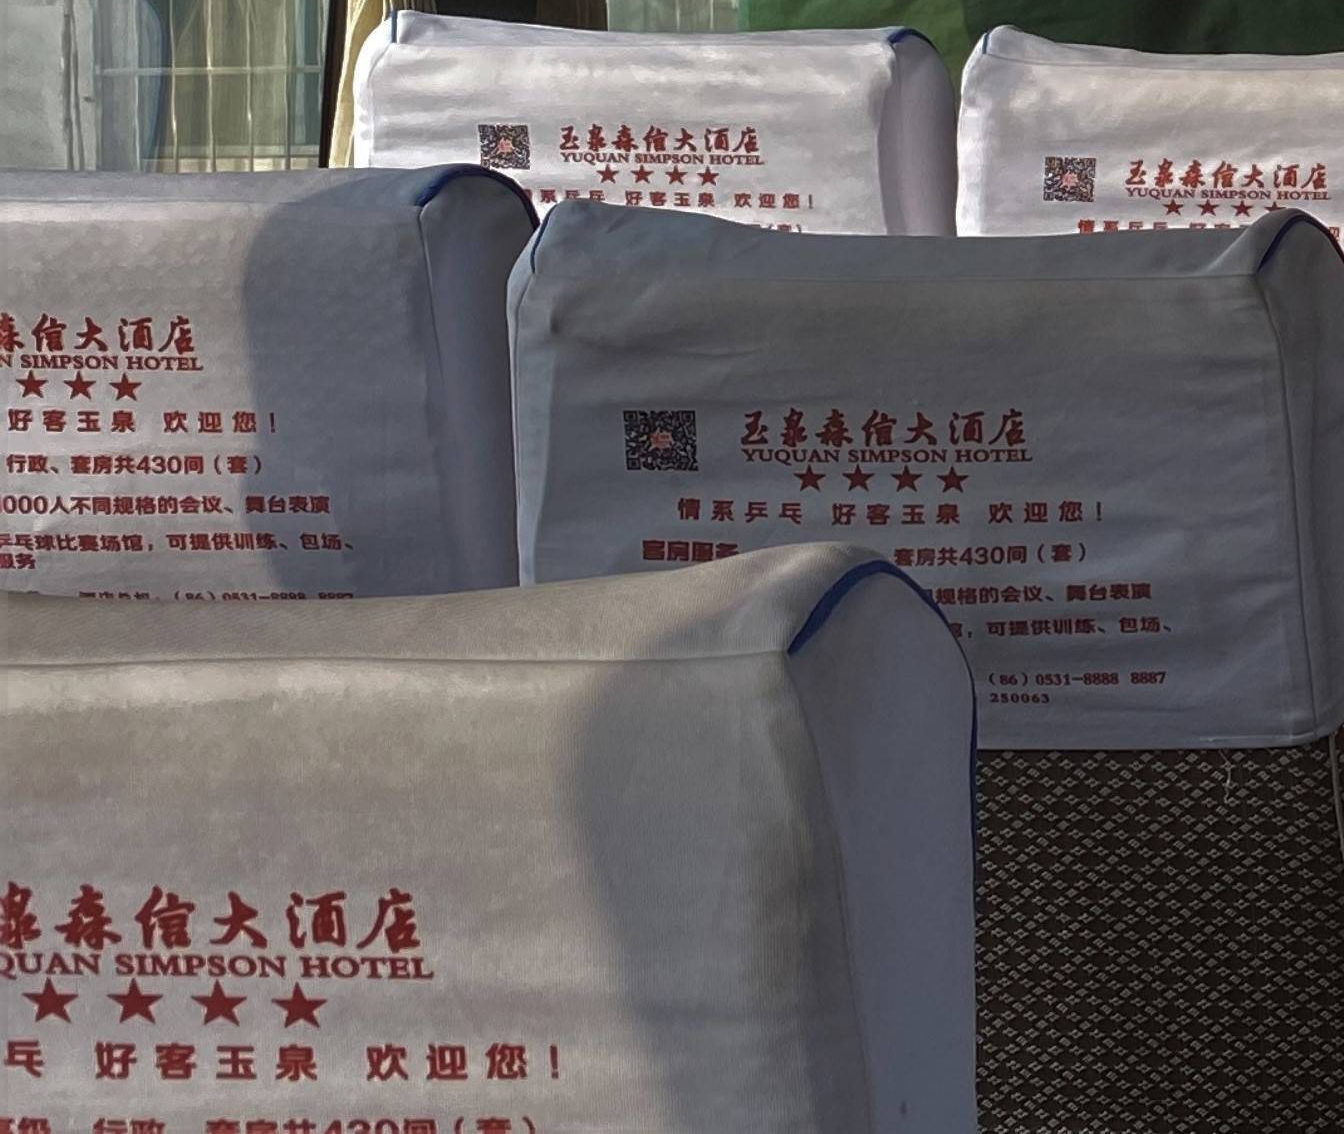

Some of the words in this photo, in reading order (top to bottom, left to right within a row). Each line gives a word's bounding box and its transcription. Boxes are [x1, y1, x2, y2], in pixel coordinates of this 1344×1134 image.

[560, 124, 758, 154] 玉泉森信大酒店
[560, 152, 630, 165] YUQUAN
[634, 153, 704, 165] SIMPSON
[710, 155, 763, 165] HOTEL
[1127, 158, 1328, 188] 玉泉森信大酒店
[624, 191, 714, 209] 好客玉泉
[1126, 187, 1197, 200] YUQUAN
[1201, 188, 1271, 201] SIMPSON
[1277, 189, 1332, 202] HOTEL
[21, 355, 118, 369] SIMPSON
[126, 356, 202, 370] HOTEL
[8, 409, 134, 432] 好客玉泉
[742, 408, 1025, 448] 玉泉森信大酒店
[742, 448, 841, 464] YUQUAN
[848, 449, 947, 463] SIMPSON
[955, 449, 1032, 463] HOTEL
[678, 498, 801, 524] 情系乒乓
[832, 504, 959, 525] 好客玉泉
[923, 582, 1154, 606] 规格的会议、舞台表演
[115, 953, 285, 977] SIMPSON
[300, 952, 433, 979] HOTEL
[96, 1042, 316, 1081] 好客玉泉
[367, 1043, 558, 1080] 欢迎您！
